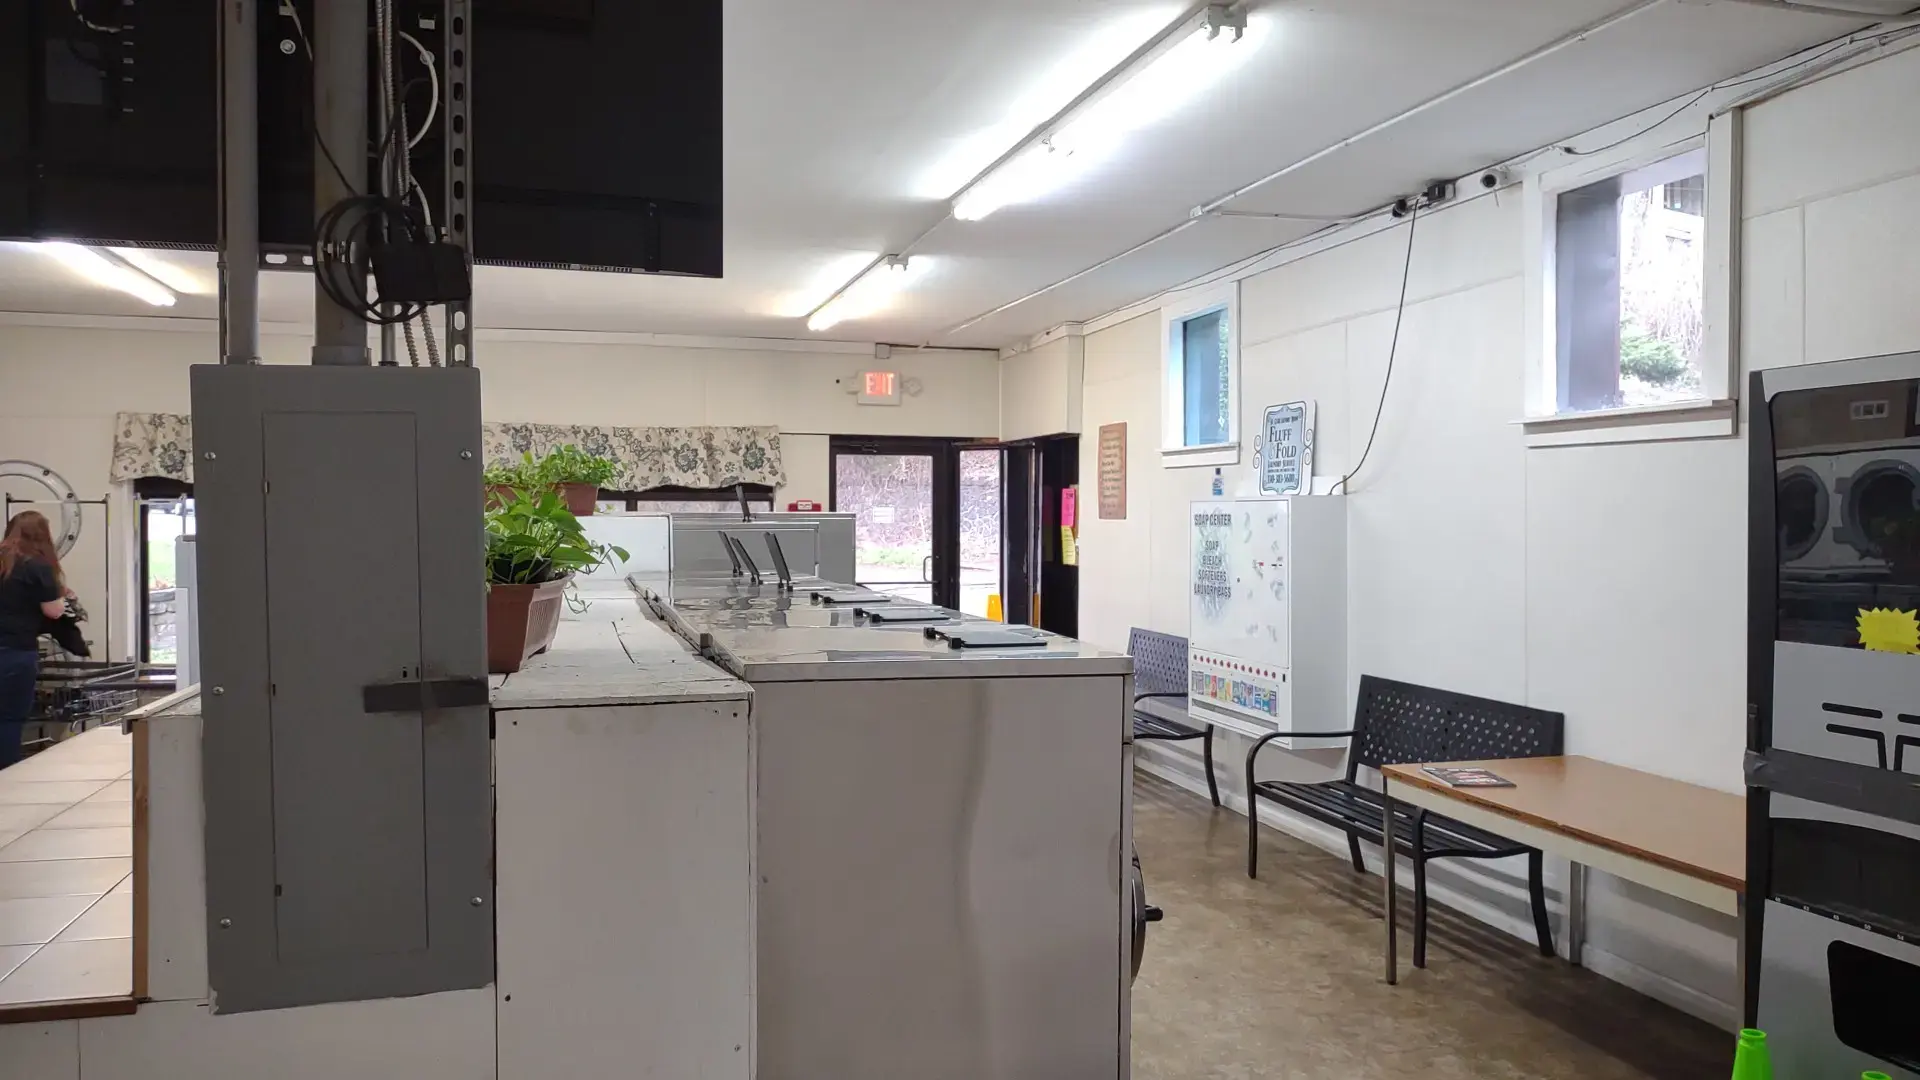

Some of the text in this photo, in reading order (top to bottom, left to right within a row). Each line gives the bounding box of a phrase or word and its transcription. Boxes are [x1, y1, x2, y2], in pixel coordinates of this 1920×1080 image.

[1269, 426, 1293, 443] FLUFF
[1275, 442, 1297, 459] FOLD
[1194, 513, 1232, 526] SOAP CENTER
[1205, 540, 1219, 551] SOAP
[1202, 555, 1222, 566] BLEACH
